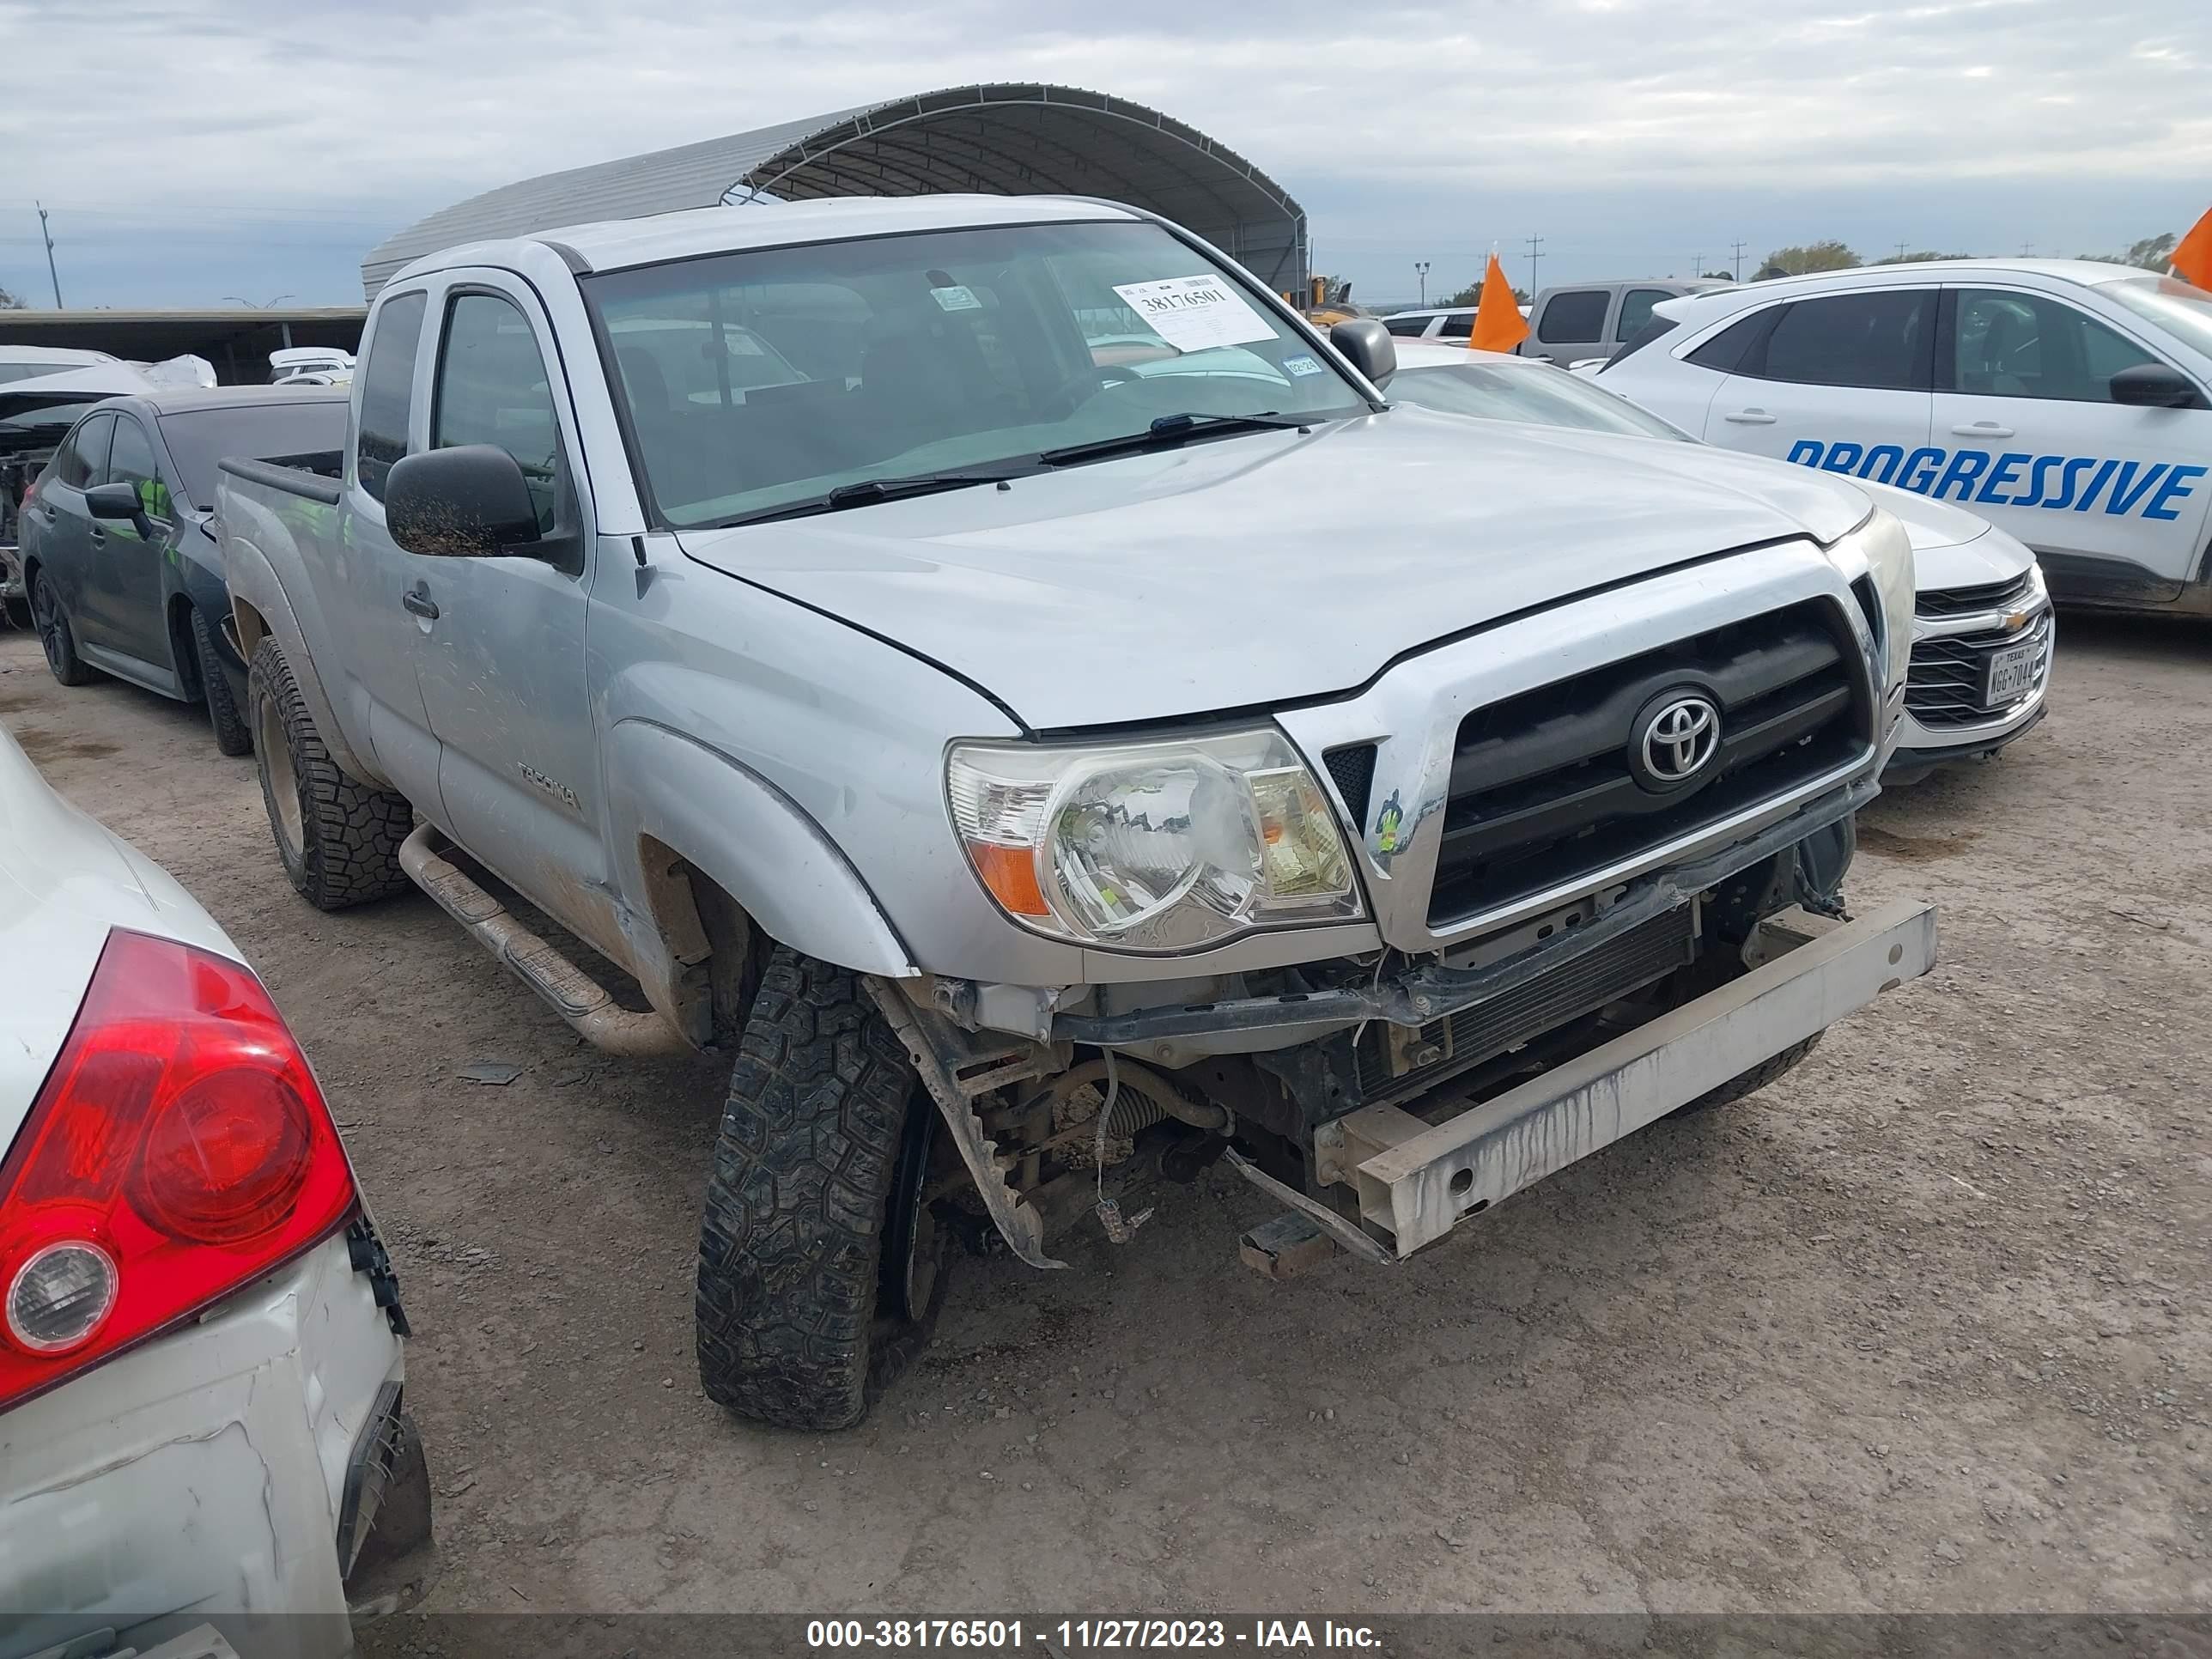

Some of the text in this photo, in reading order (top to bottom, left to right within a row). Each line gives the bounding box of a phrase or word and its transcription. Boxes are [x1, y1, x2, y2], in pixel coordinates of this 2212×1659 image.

[1140, 289, 1227, 313] 38176501
[1786, 440, 2208, 520] PROGRESSIVE
[2007, 649, 2026, 663] TEXAS
[517, 761, 581, 811] TACOMA
